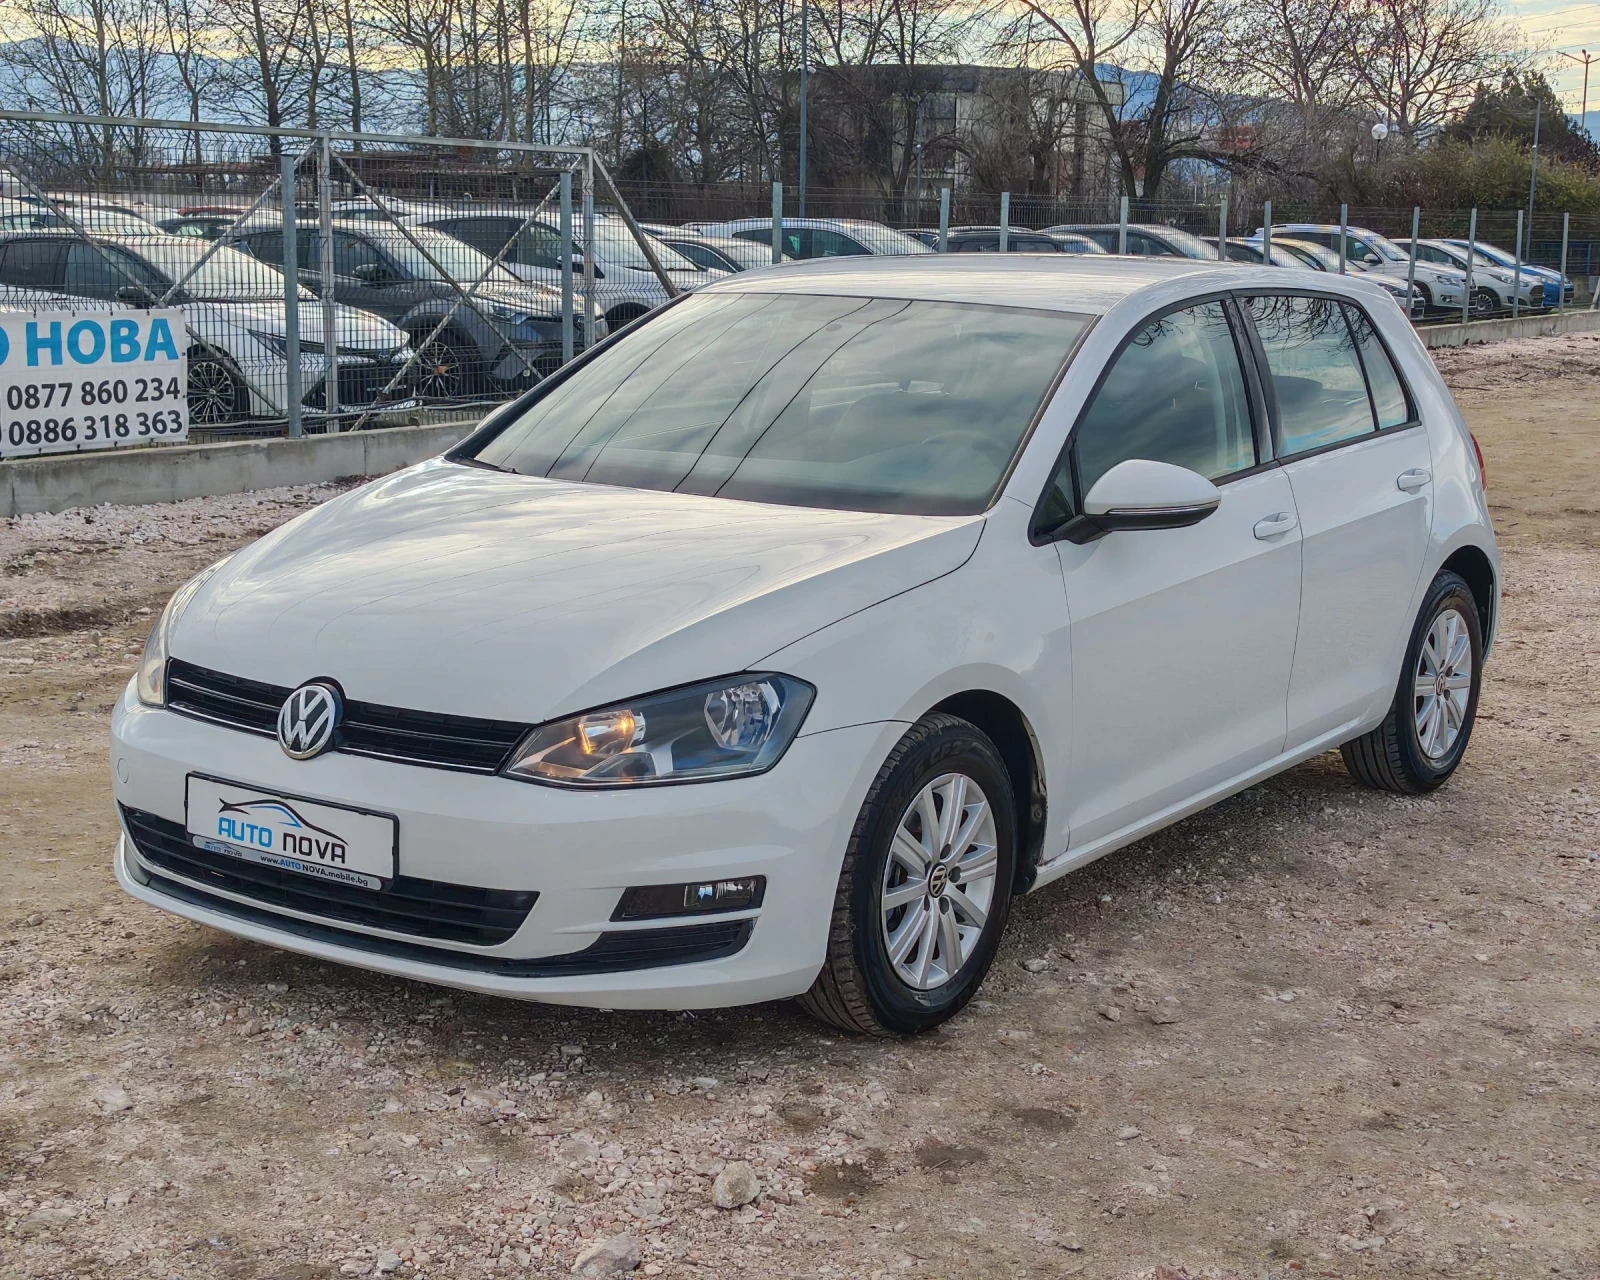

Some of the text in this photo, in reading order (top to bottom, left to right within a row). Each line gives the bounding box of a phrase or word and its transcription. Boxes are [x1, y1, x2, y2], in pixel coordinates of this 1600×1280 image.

[7, 376, 181, 411] 0877 860 234
[8, 409, 183, 446] 0886 318 363
[218, 817, 273, 848] AUTO
